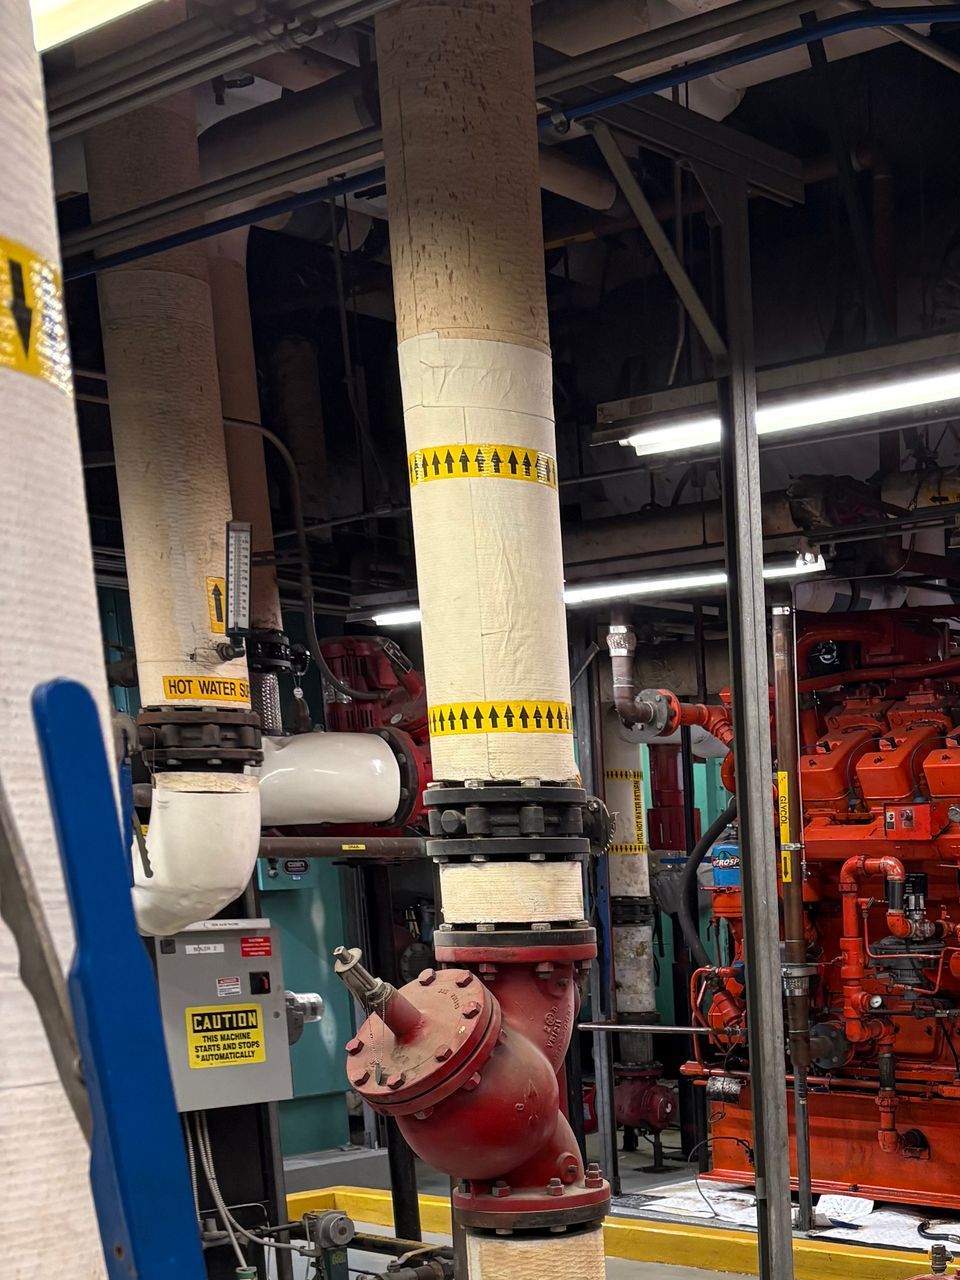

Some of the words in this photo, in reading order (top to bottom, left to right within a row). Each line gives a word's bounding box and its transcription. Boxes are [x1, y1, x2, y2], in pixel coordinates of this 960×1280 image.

[168, 679, 193, 694] HOT
[198, 680, 237, 696] WATER
[780, 795, 788, 825] GLYCOL
[193, 1012, 257, 1030] CAUTION
[202, 1035, 218, 1043] THIS
[220, 1032, 251, 1042] MACHINE
[195, 1044, 221, 1053] STARTS
[223, 1043, 236, 1051] AND
[238, 1041, 260, 1049] STOPS
[201, 1050, 255, 1061] AUTOMATICALLY
